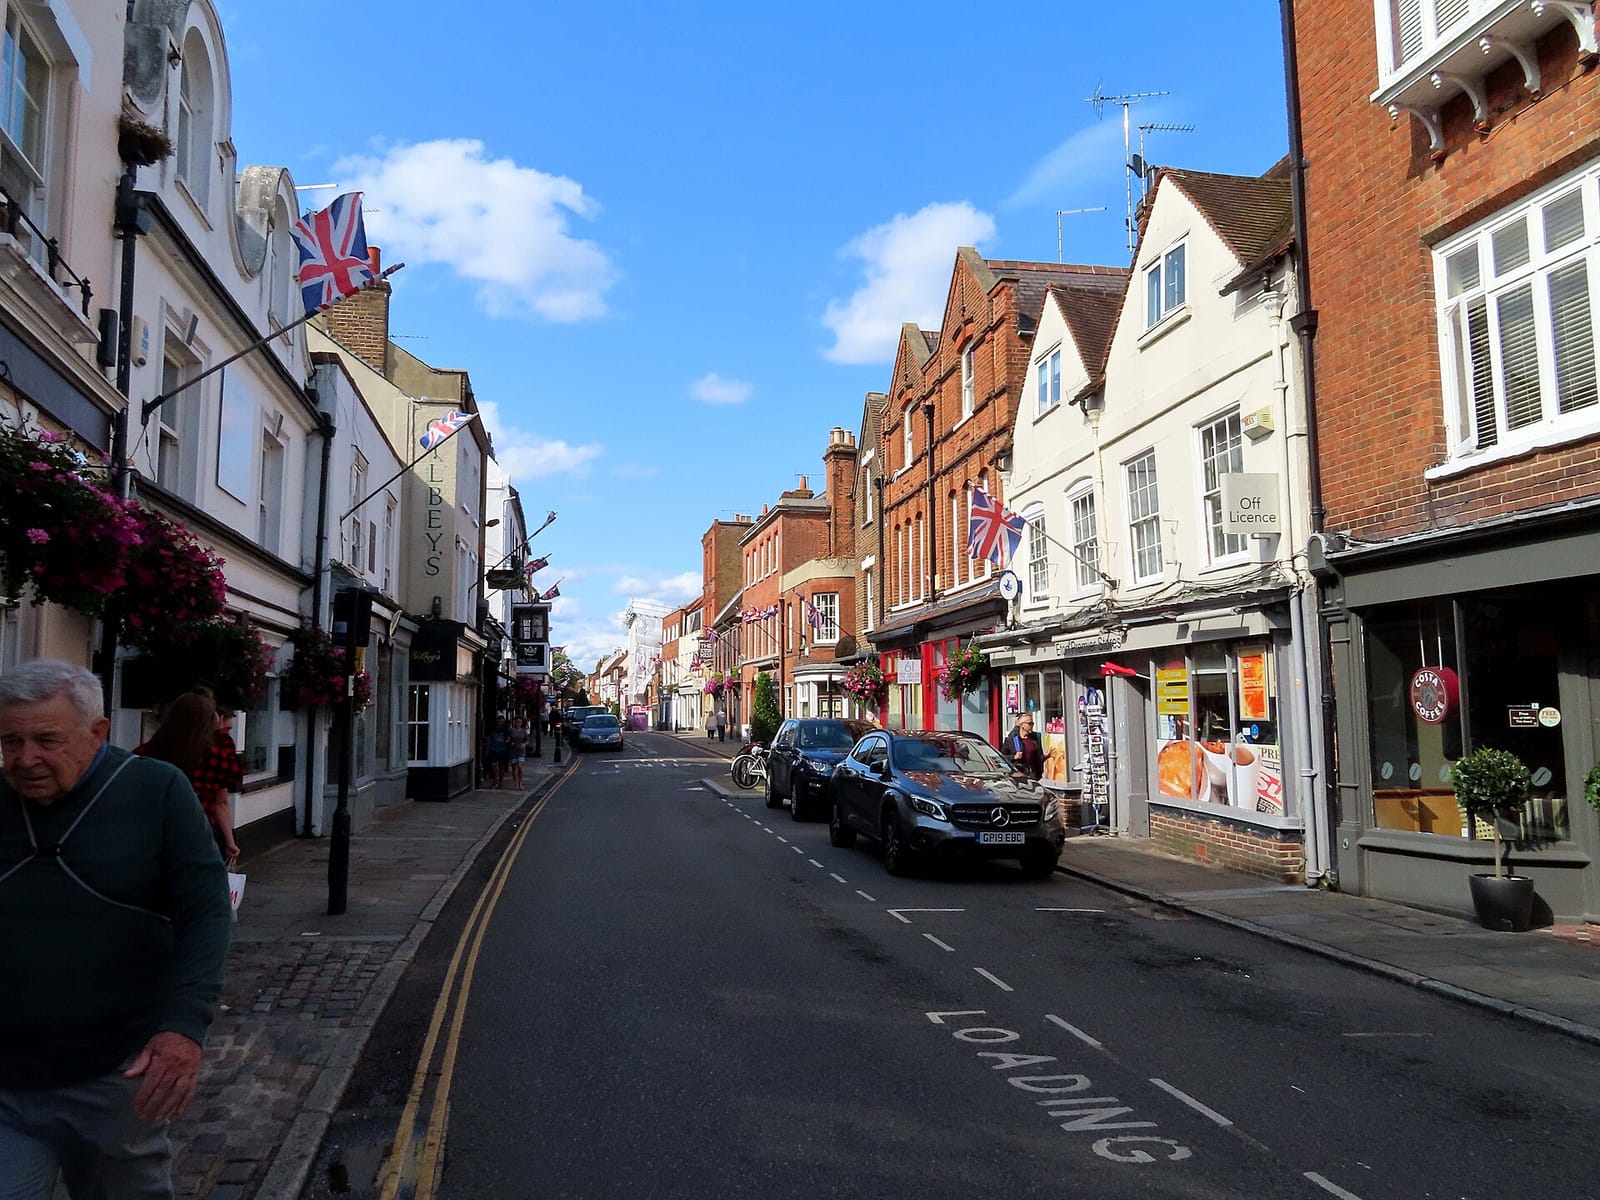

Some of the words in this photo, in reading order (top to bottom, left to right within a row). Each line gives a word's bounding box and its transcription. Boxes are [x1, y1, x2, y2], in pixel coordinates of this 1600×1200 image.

[1240, 496, 1262, 510] Off
[1229, 511, 1277, 523] Licence
[1415, 672, 1439, 688] COSTA
[1415, 700, 1446, 720] COFFEE
[983, 833, 1003, 842] GP19
[926, 1009, 1193, 1163] LOADING
